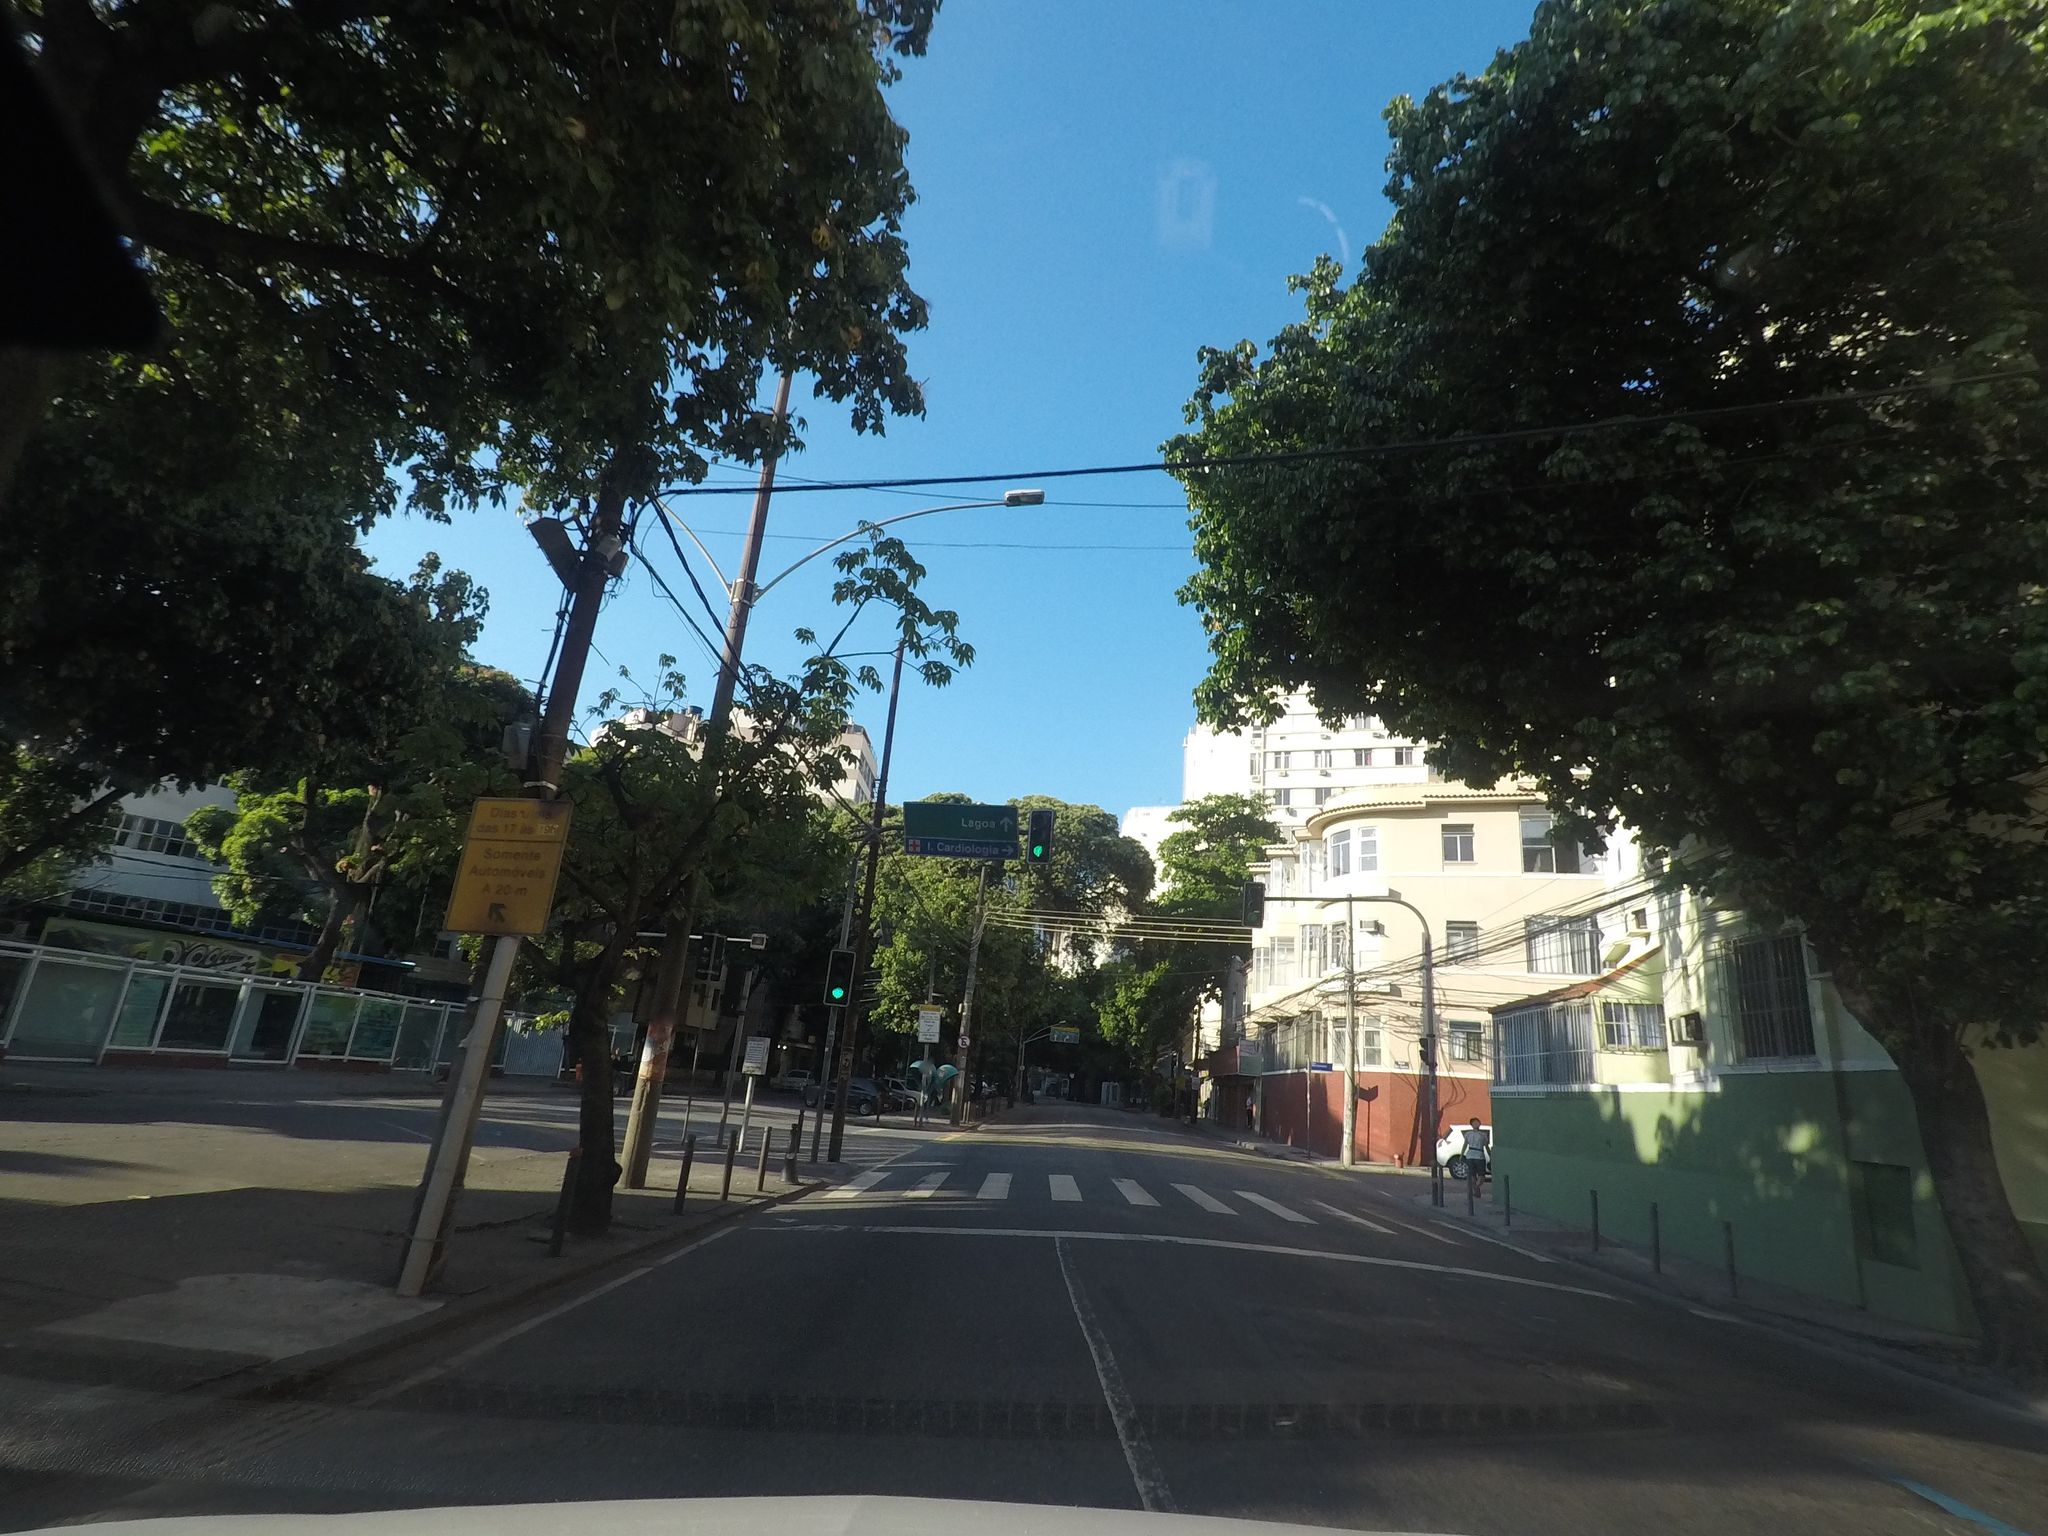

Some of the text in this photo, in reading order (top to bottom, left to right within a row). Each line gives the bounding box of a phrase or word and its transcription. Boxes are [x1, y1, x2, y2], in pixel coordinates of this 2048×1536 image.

[504, 823, 517, 833] 17
[961, 818, 996, 830] Lagoa
[484, 848, 541, 861] Somente
[936, 842, 999, 857] Cardiologia
[469, 864, 545, 878] Automóveis
[495, 883, 512, 895] 20
